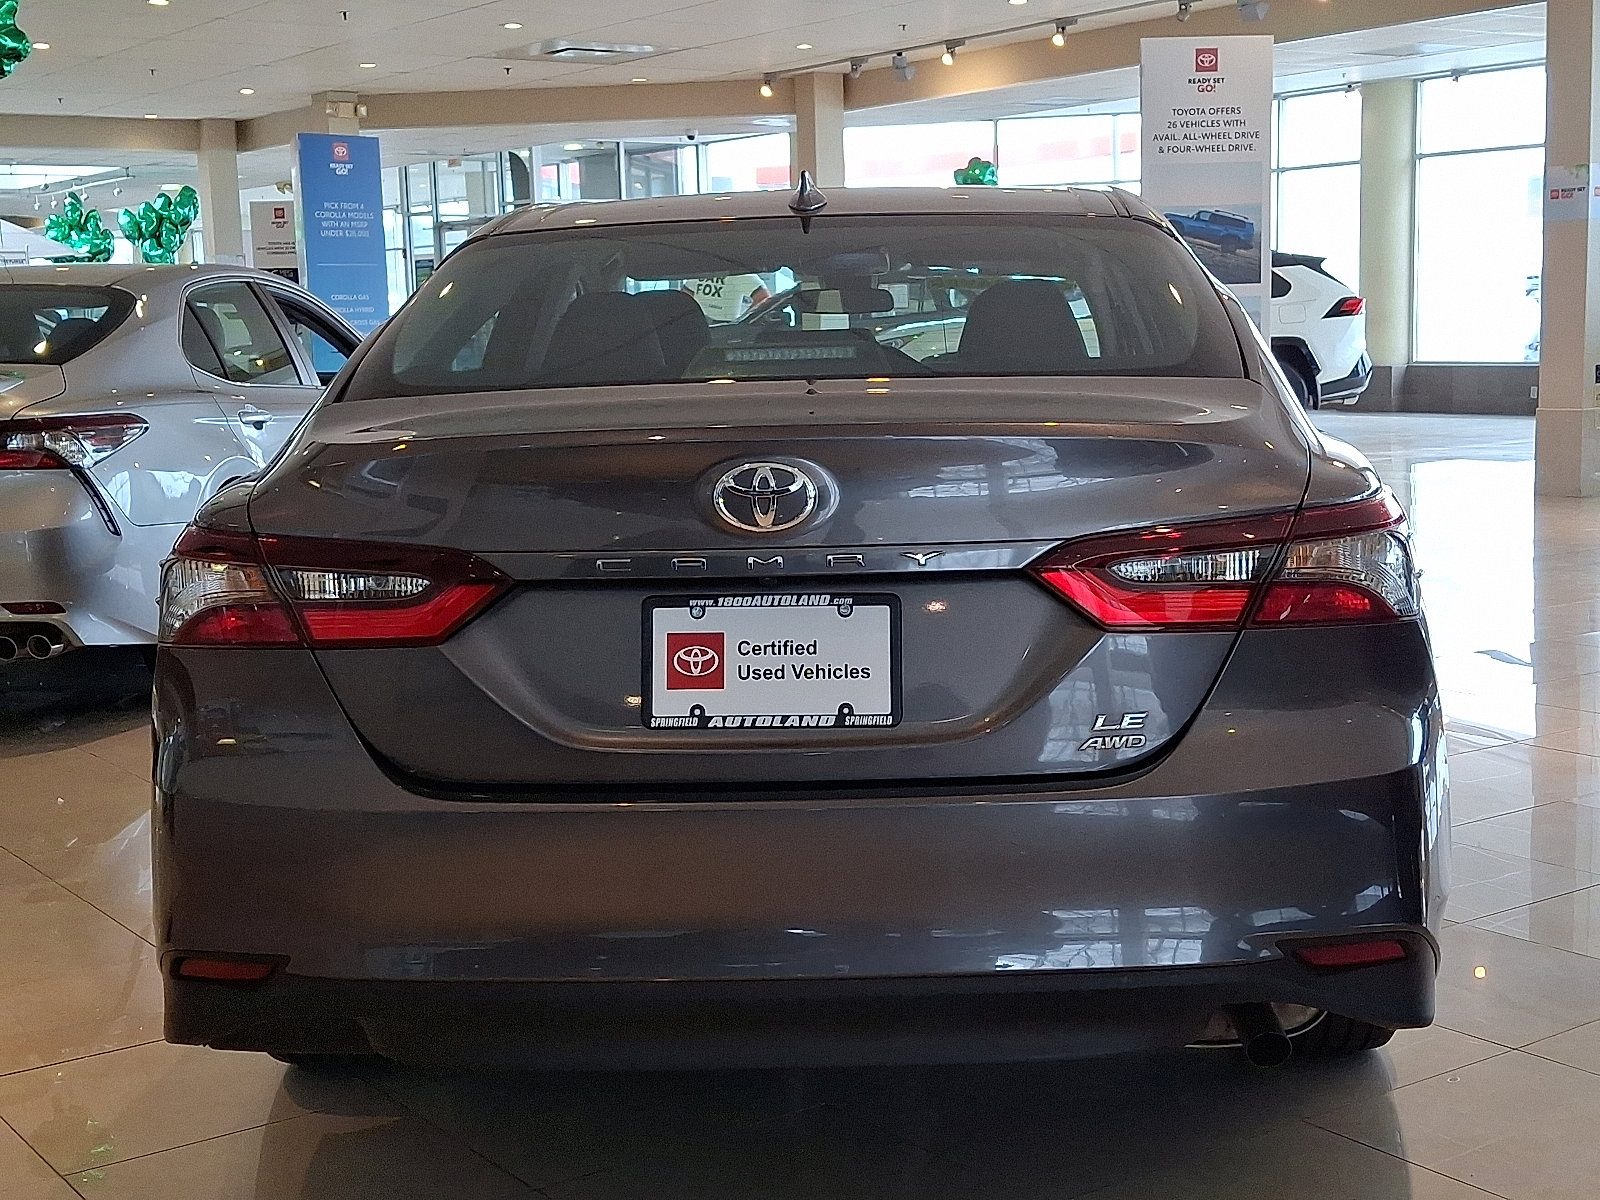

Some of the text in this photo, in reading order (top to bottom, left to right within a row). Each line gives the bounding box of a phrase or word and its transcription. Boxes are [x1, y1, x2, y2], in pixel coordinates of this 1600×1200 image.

[1197, 84, 1216, 92] GO!
[1172, 106, 1241, 116] TOYOTA OFFERS
[1167, 119, 1246, 129] 26 VEHICLES WITH
[1153, 131, 1260, 141] AVAIL. ALL-WHEEL DRIVE
[1167, 144, 1226, 153] FOUR-WHEEL
[1228, 143, 1256, 152] DRIVE.
[696, 284, 722, 297] FOX
[596, 551, 946, 571] CAMRY
[737, 640, 818, 656] Certified
[737, 664, 871, 680] Used Vehicles
[650, 716, 893, 728] SPRINGFIELD AUTOLAND SPRINGFIELD
[1091, 711, 1149, 731] LE
[1078, 734, 1147, 751] AWD
